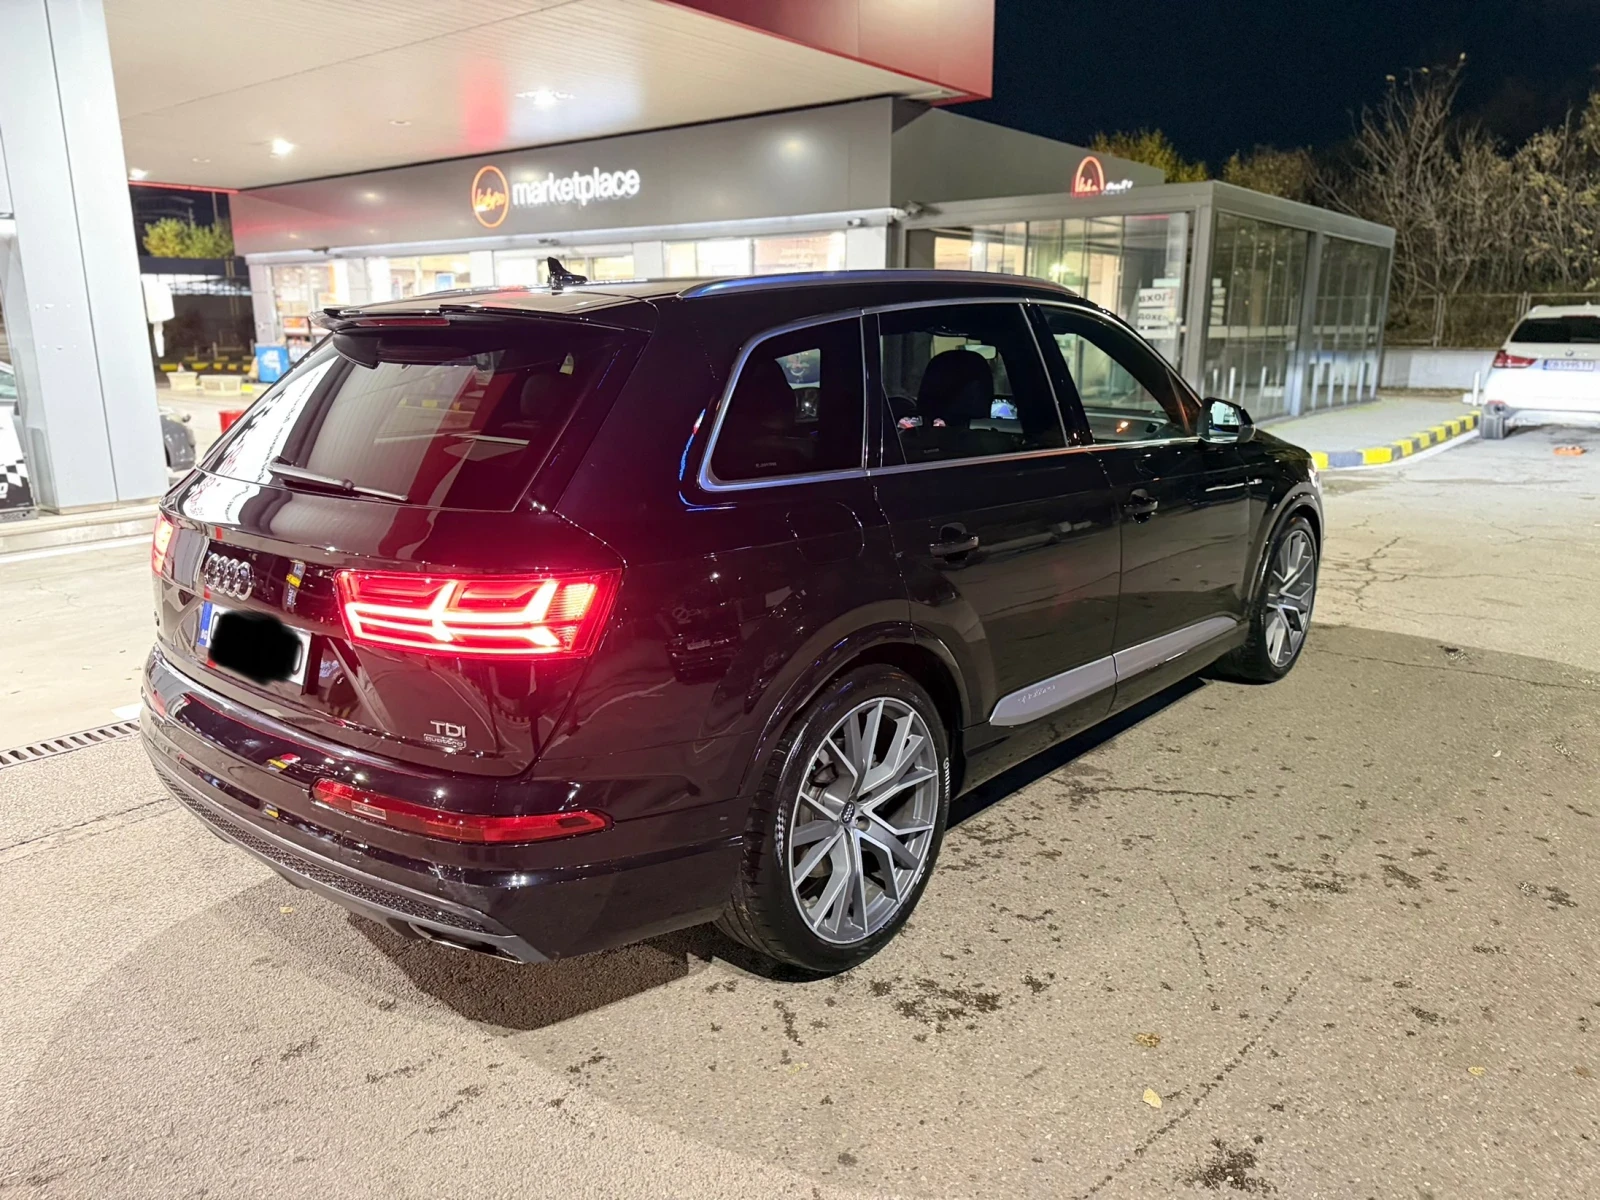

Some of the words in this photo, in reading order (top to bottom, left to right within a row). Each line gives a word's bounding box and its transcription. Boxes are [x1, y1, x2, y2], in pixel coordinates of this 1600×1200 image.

[512, 166, 641, 207] marketplace
[430, 720, 466, 739] TDI
[425, 736, 464, 747] quattro
